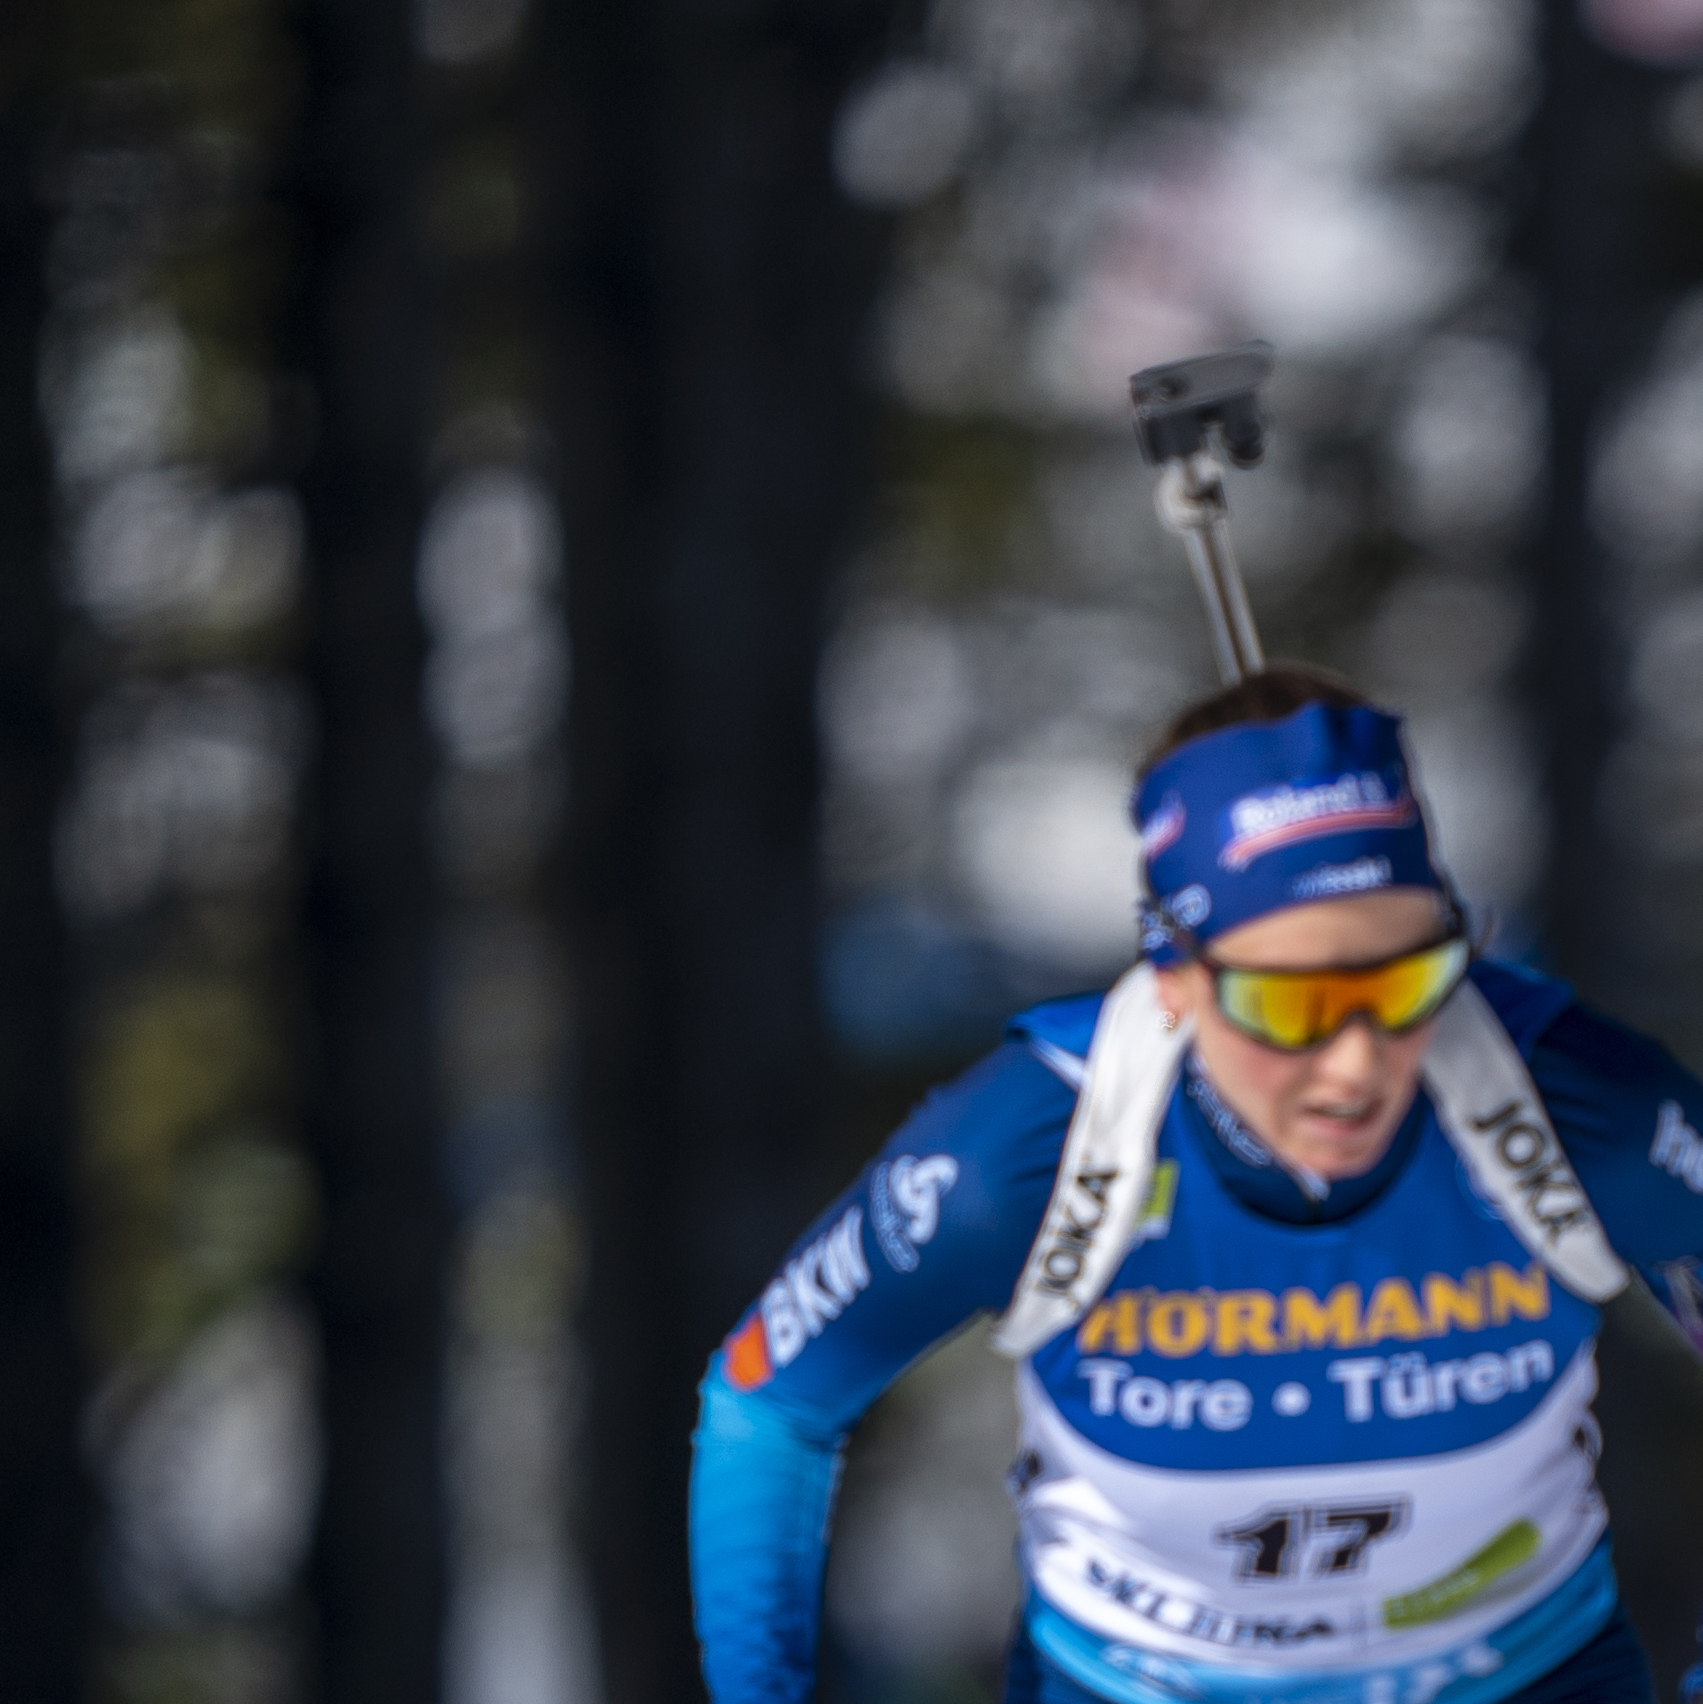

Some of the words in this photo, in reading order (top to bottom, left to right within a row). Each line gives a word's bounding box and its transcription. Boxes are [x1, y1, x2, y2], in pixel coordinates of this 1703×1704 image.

[760, 1204, 872, 1368] BKW
[1078, 1360, 1252, 1430] Tore
[1328, 1340, 1554, 1422] Türen
[1216, 1498, 1410, 1582] 17
